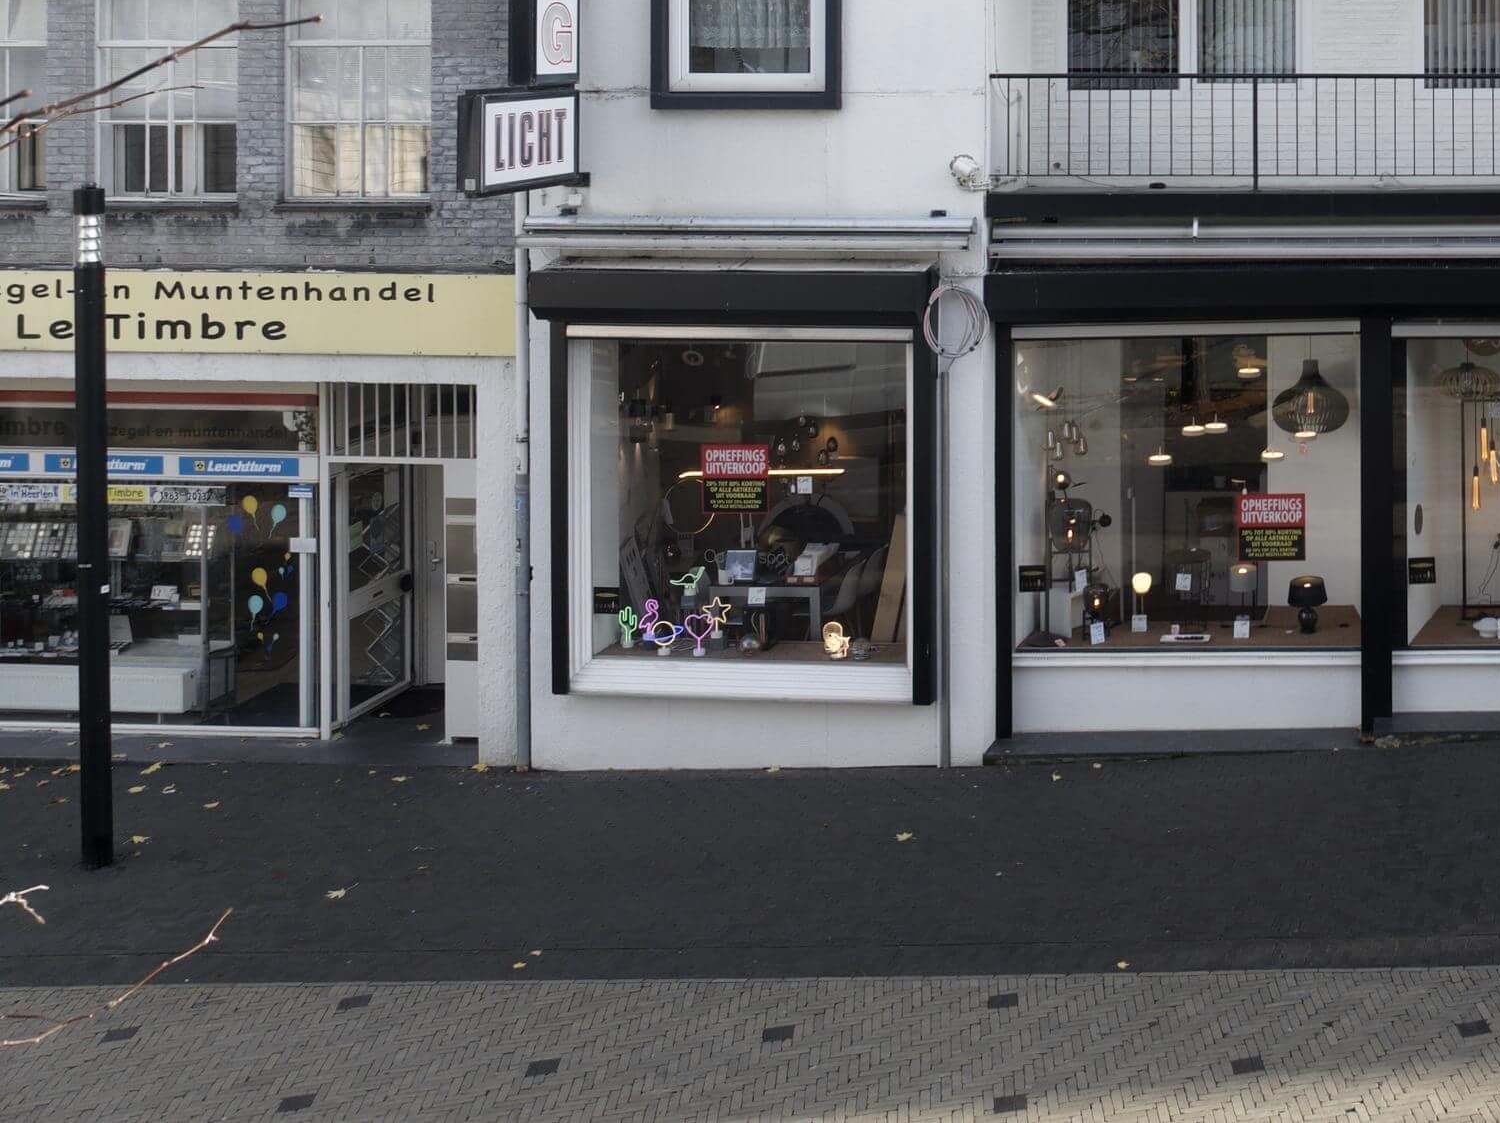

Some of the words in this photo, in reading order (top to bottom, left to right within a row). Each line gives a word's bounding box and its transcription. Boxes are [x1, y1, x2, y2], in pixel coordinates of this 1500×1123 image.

[494, 108, 568, 172] LICHT
[155, 281, 435, 303] Muntenhandel
[17, 313, 74, 339] Le
[104, 313, 287, 341] Timbre
[705, 449, 766, 461] OPHEFFINGS
[206, 460, 281, 473] Leuchtturm
[705, 462, 766, 474] UITVERKOOP
[1241, 498, 1303, 511] OPHEFFINGS
[1241, 511, 1302, 524] UITVERKOOP
